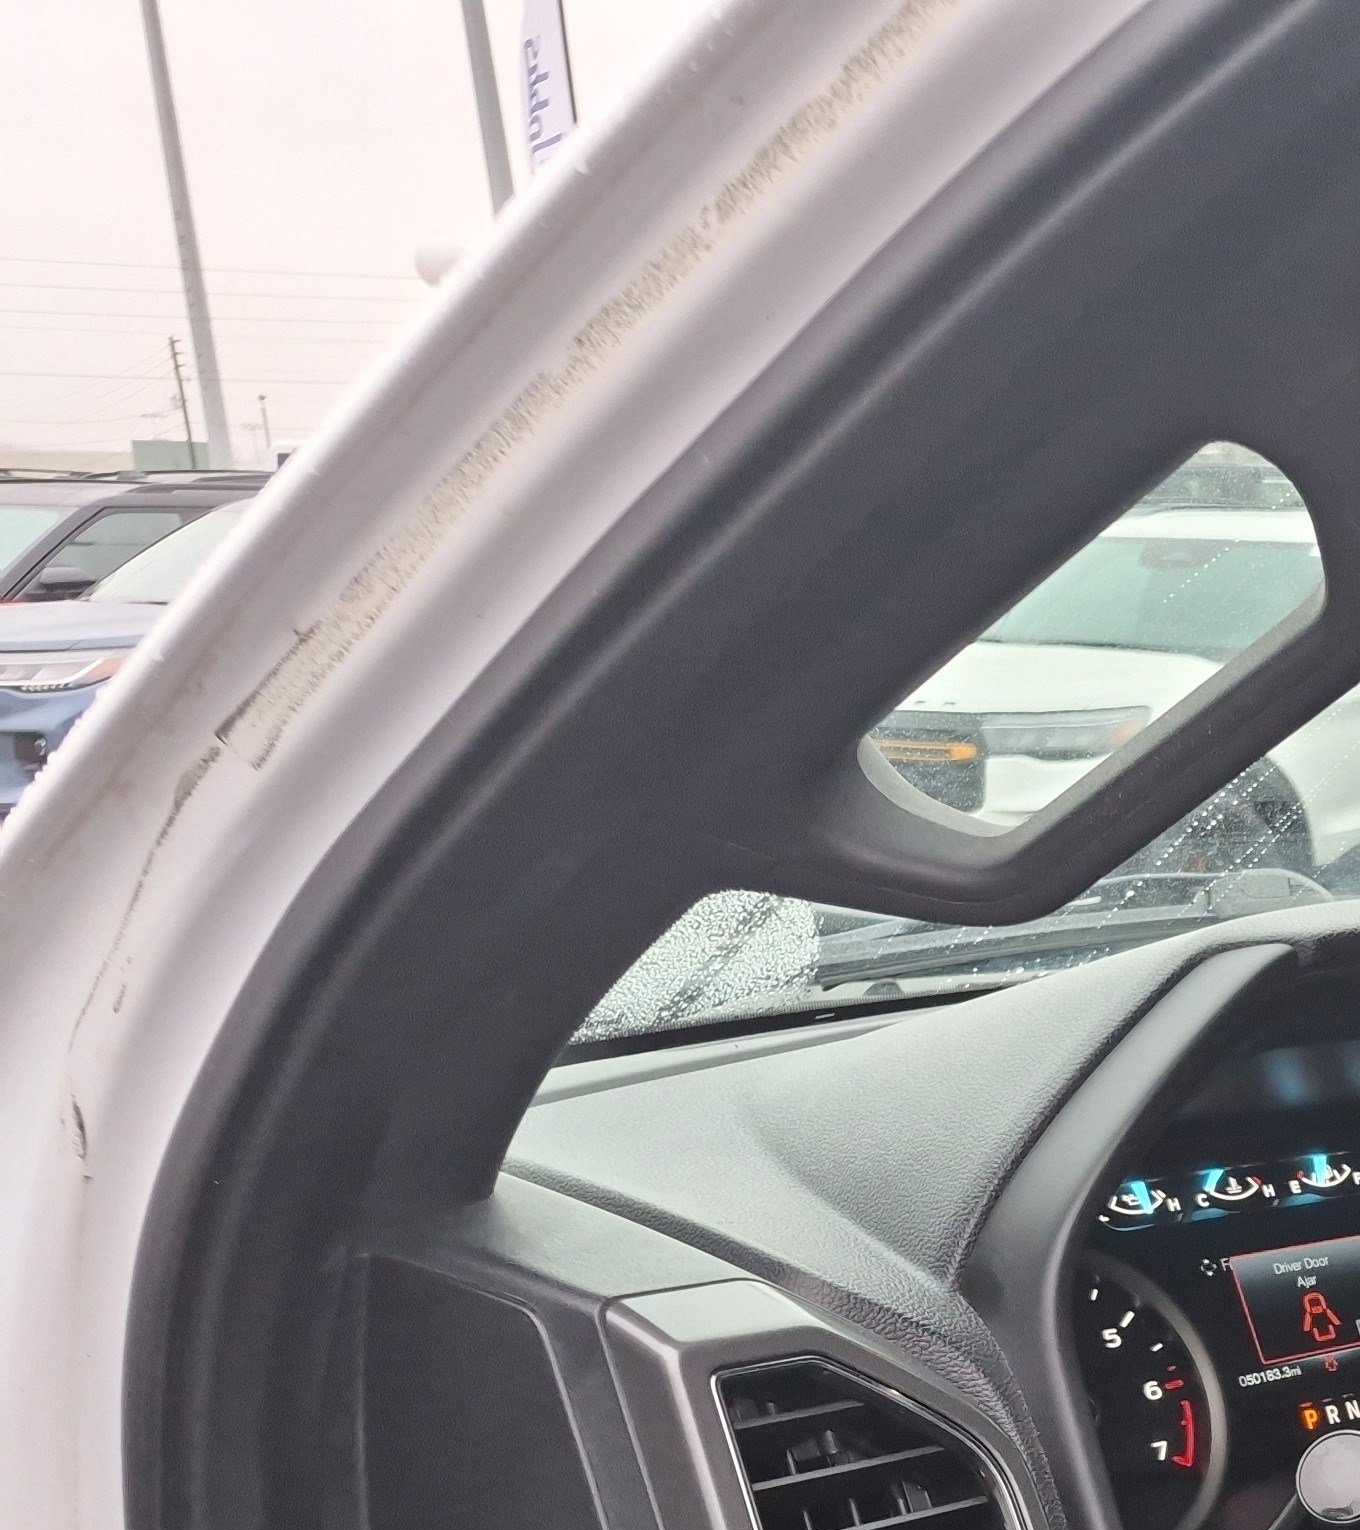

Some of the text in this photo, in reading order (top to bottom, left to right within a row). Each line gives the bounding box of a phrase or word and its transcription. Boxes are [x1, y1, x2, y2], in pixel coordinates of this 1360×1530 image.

[1195, 1183, 1276, 1208] C H
[1288, 1179, 1303, 1194] E
[1165, 1197, 1182, 1212] H
[1273, 1254, 1329, 1275] Driver Door
[1296, 1274, 1317, 1289] Ajar
[1102, 1328, 1122, 1349] 5
[1143, 1380, 1163, 1401] 6
[1303, 1409, 1319, 1430] P
[1324, 1404, 1341, 1425] R
[1344, 1399, 1360, 1420] N
[1150, 1440, 1168, 1461] 7
